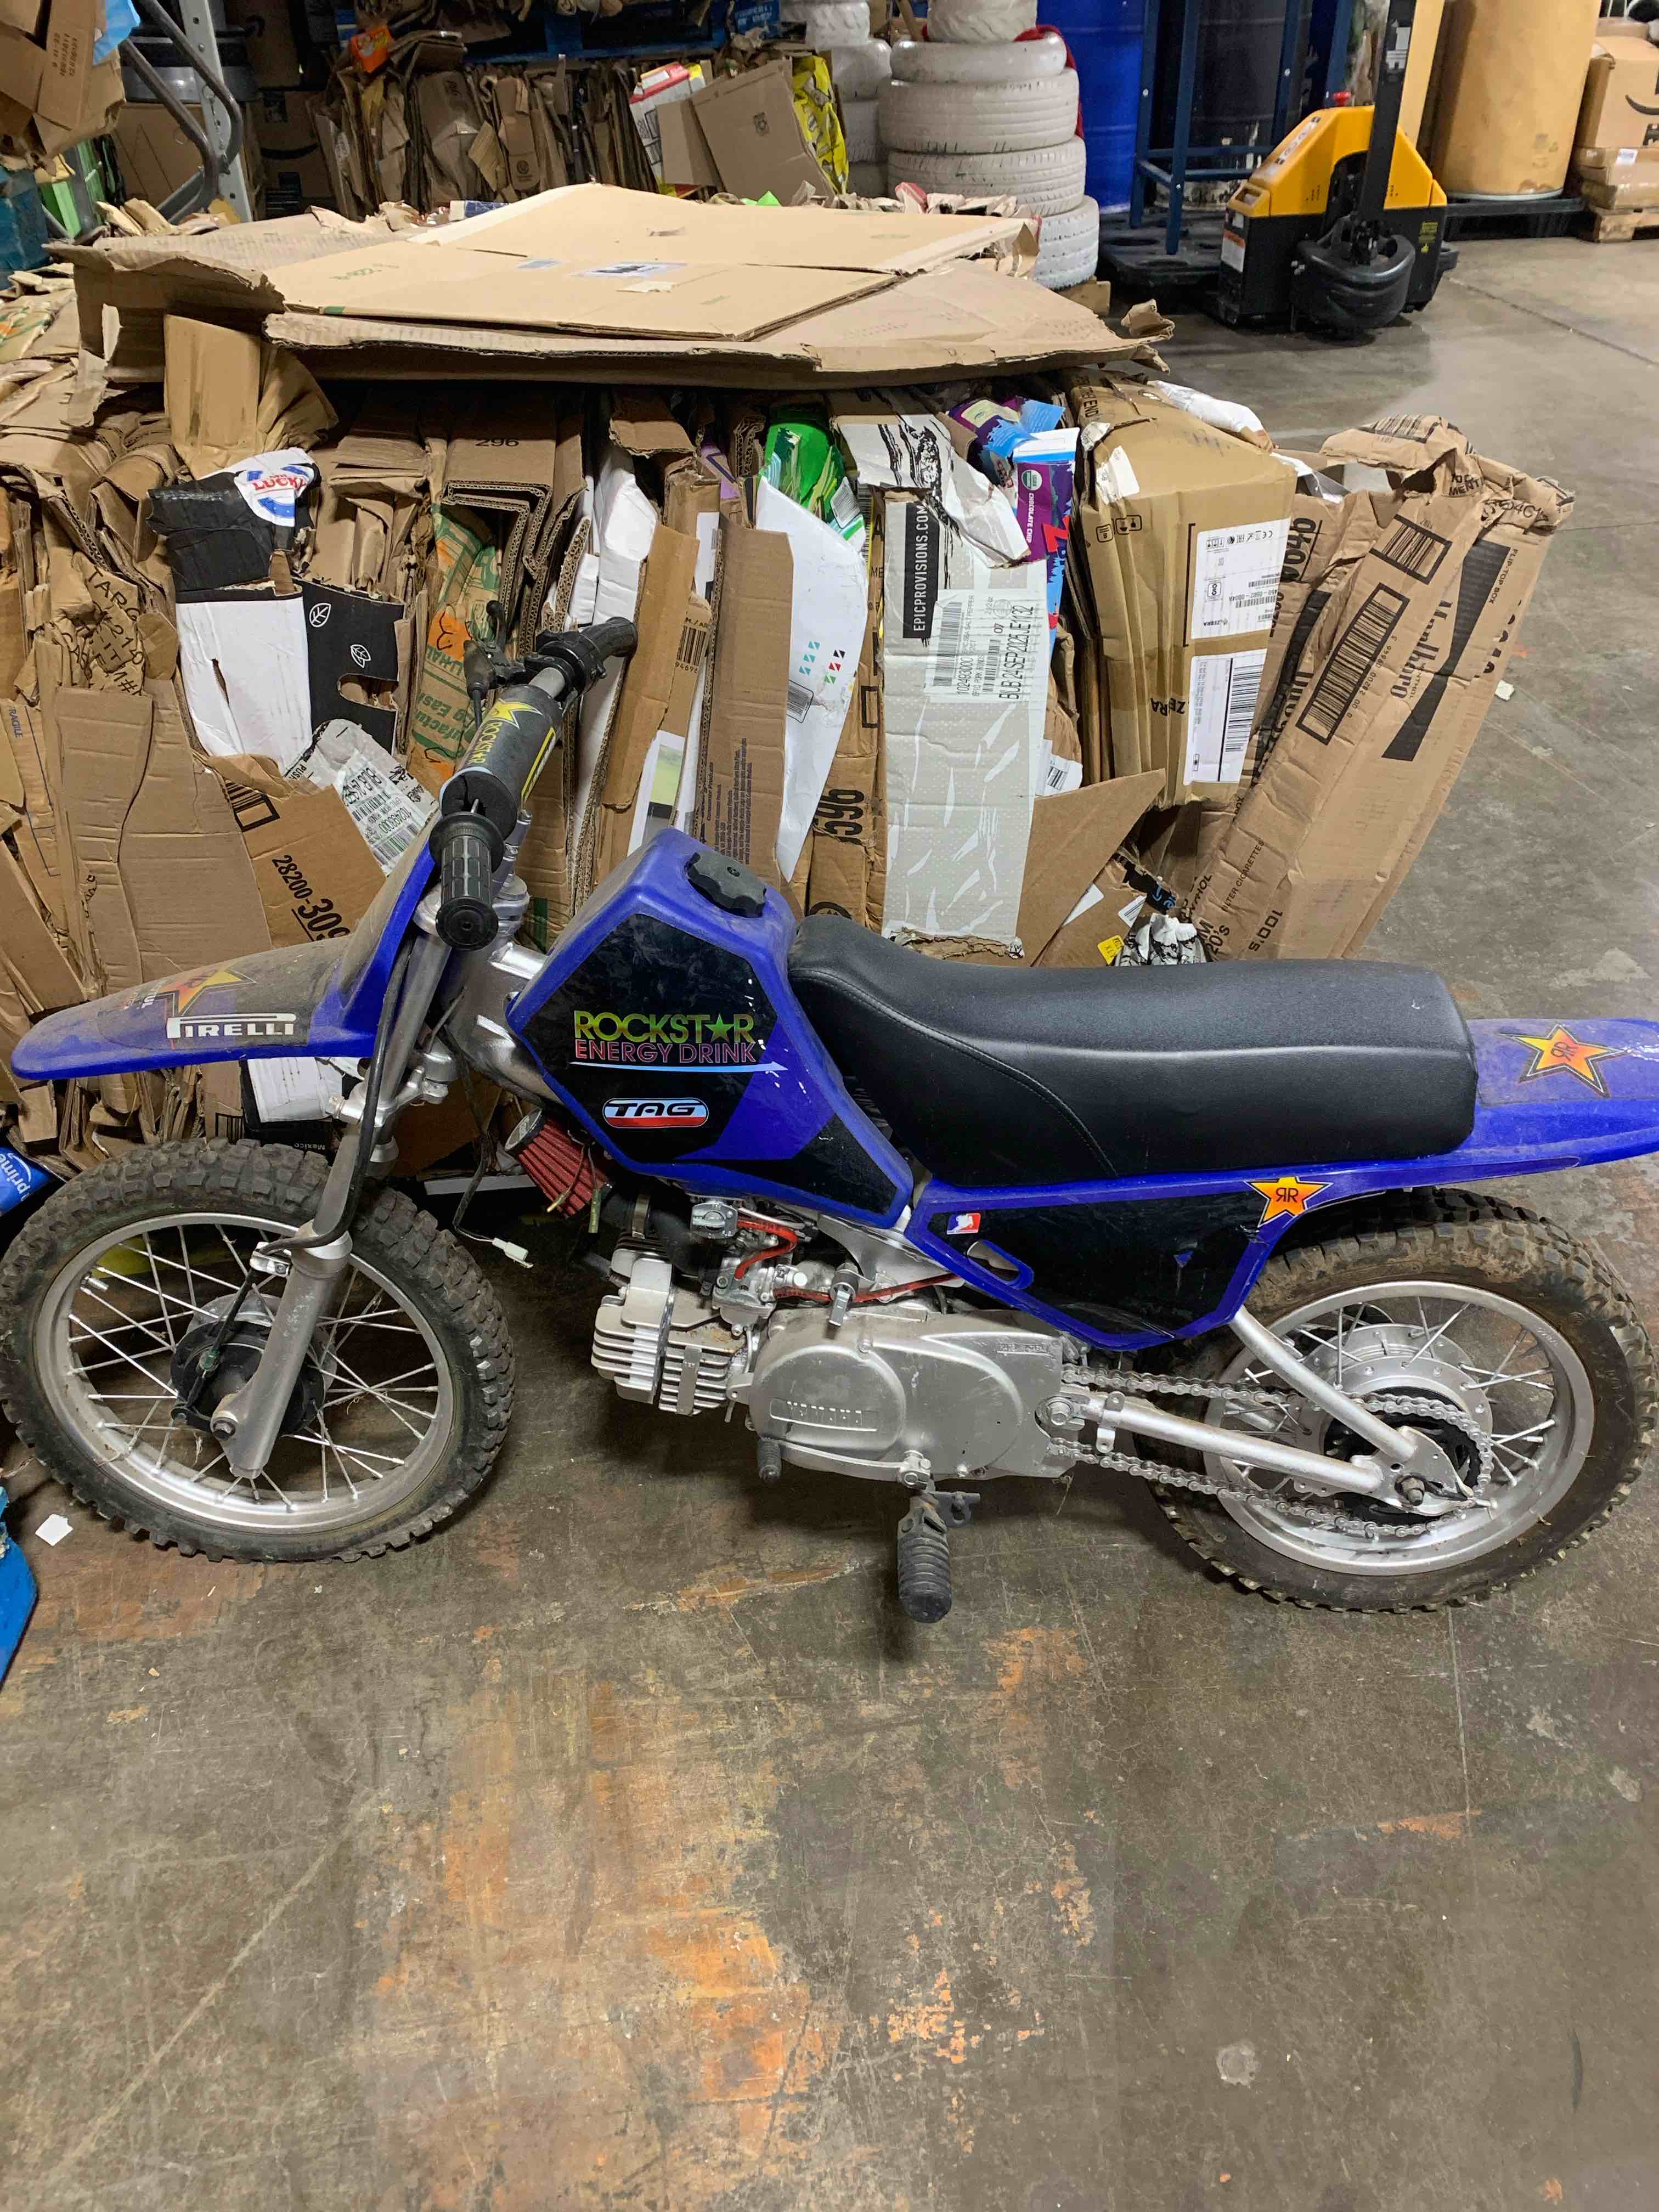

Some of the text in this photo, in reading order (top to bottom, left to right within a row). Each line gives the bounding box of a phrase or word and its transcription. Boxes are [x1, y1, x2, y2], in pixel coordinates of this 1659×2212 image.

[252, 477, 307, 492] LUCKY
[913, 505, 929, 632] EPICPROVISIONS.COM
[994, 623, 1004, 634] 07
[8, 706, 23, 738] RAGILE
[166, 1013, 297, 1039] PIRELLI
[575, 1039, 757, 1064] ENERGY DRINK
[607, 1102, 705, 1117] TAG
[294, 1142, 326, 1150] Mexico
